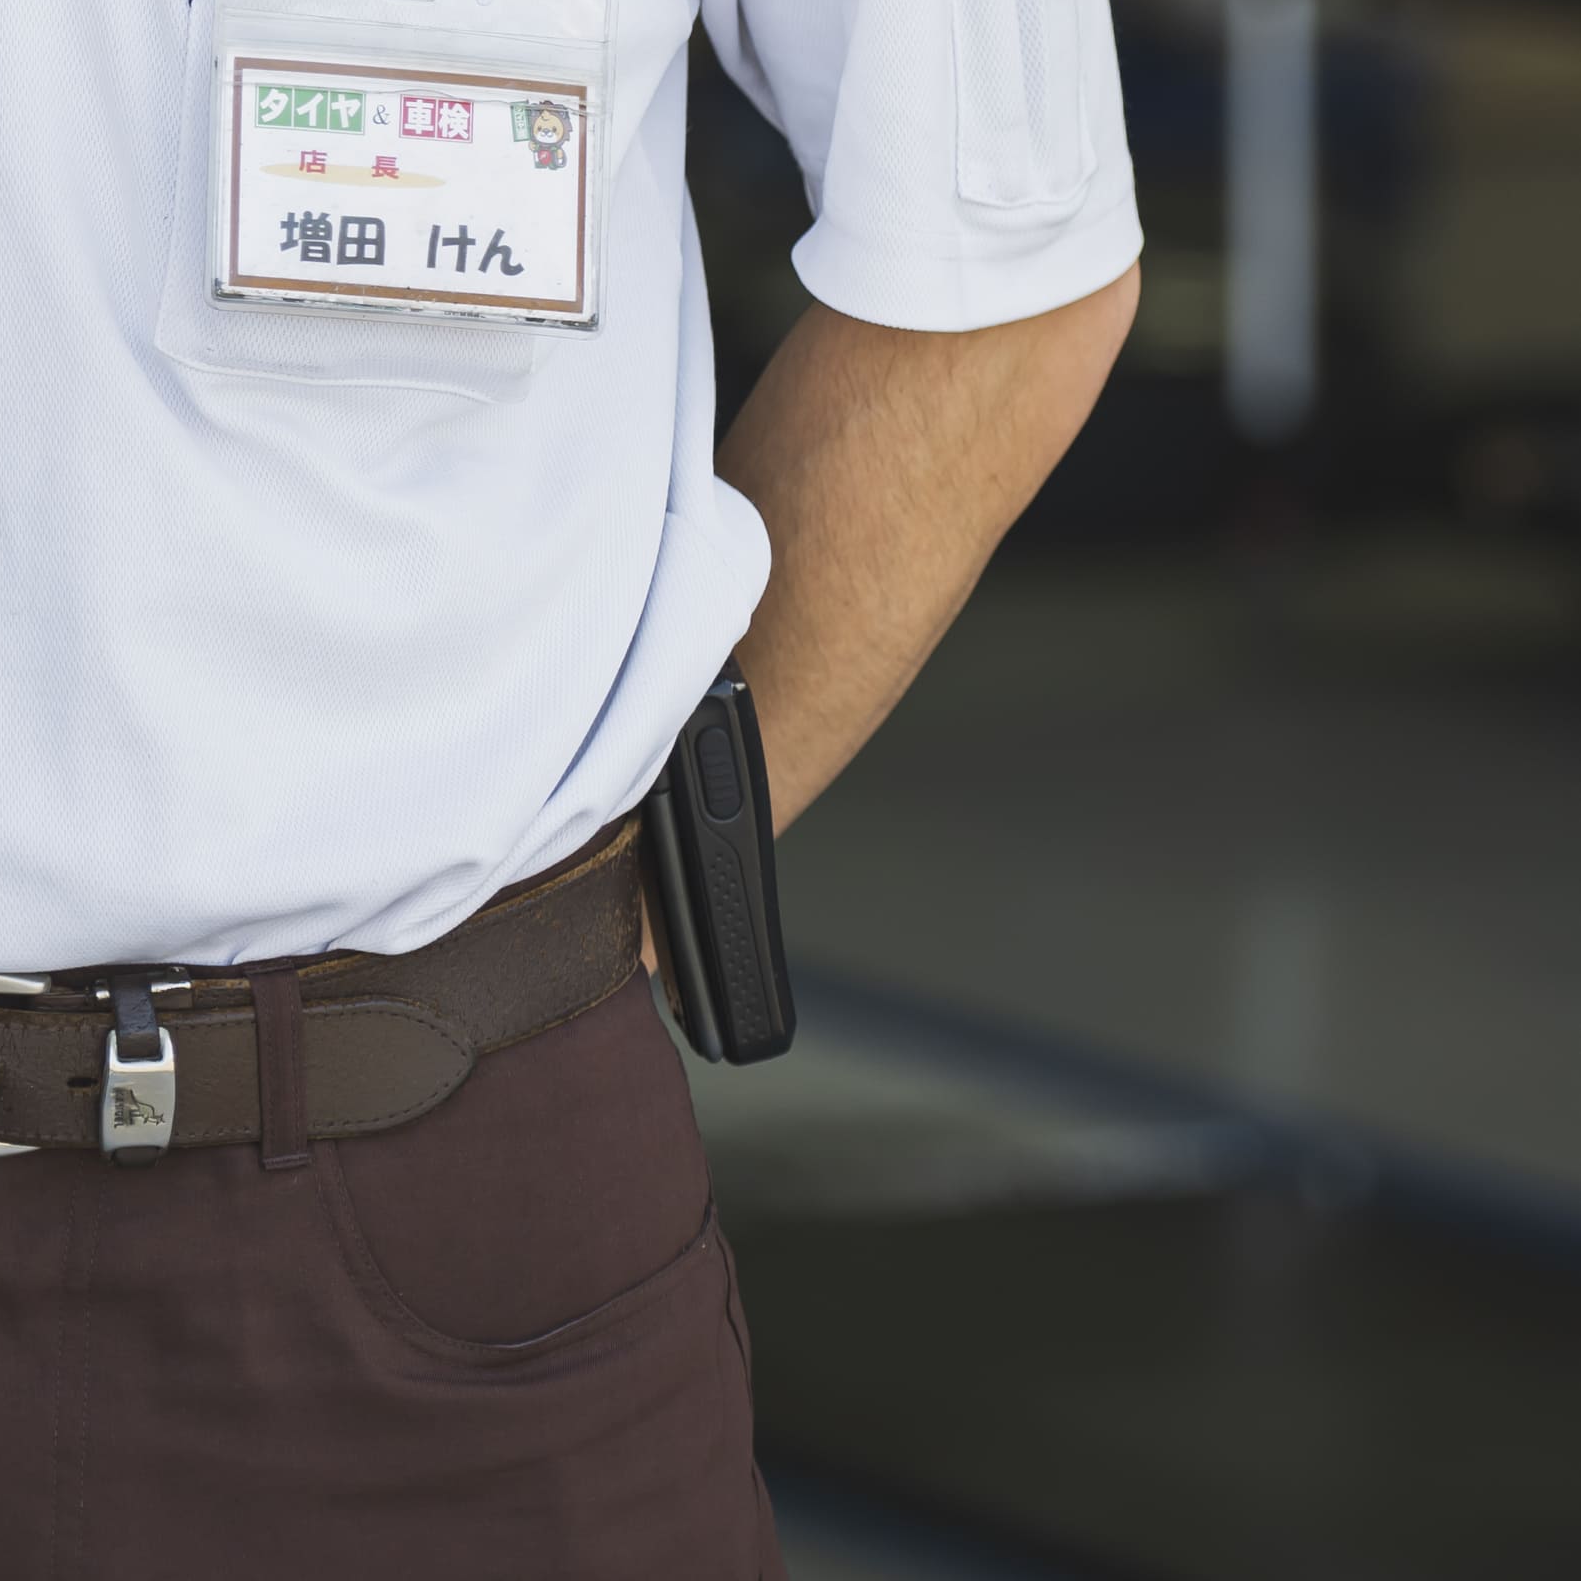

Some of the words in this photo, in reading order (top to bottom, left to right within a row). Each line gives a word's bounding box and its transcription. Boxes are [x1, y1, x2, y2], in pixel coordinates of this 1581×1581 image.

[260, 89, 362, 128] タイヤ
[372, 104, 391, 126] &
[404, 99, 470, 139] 車検
[279, 210, 385, 266] 増田
[426, 224, 525, 276] けん
